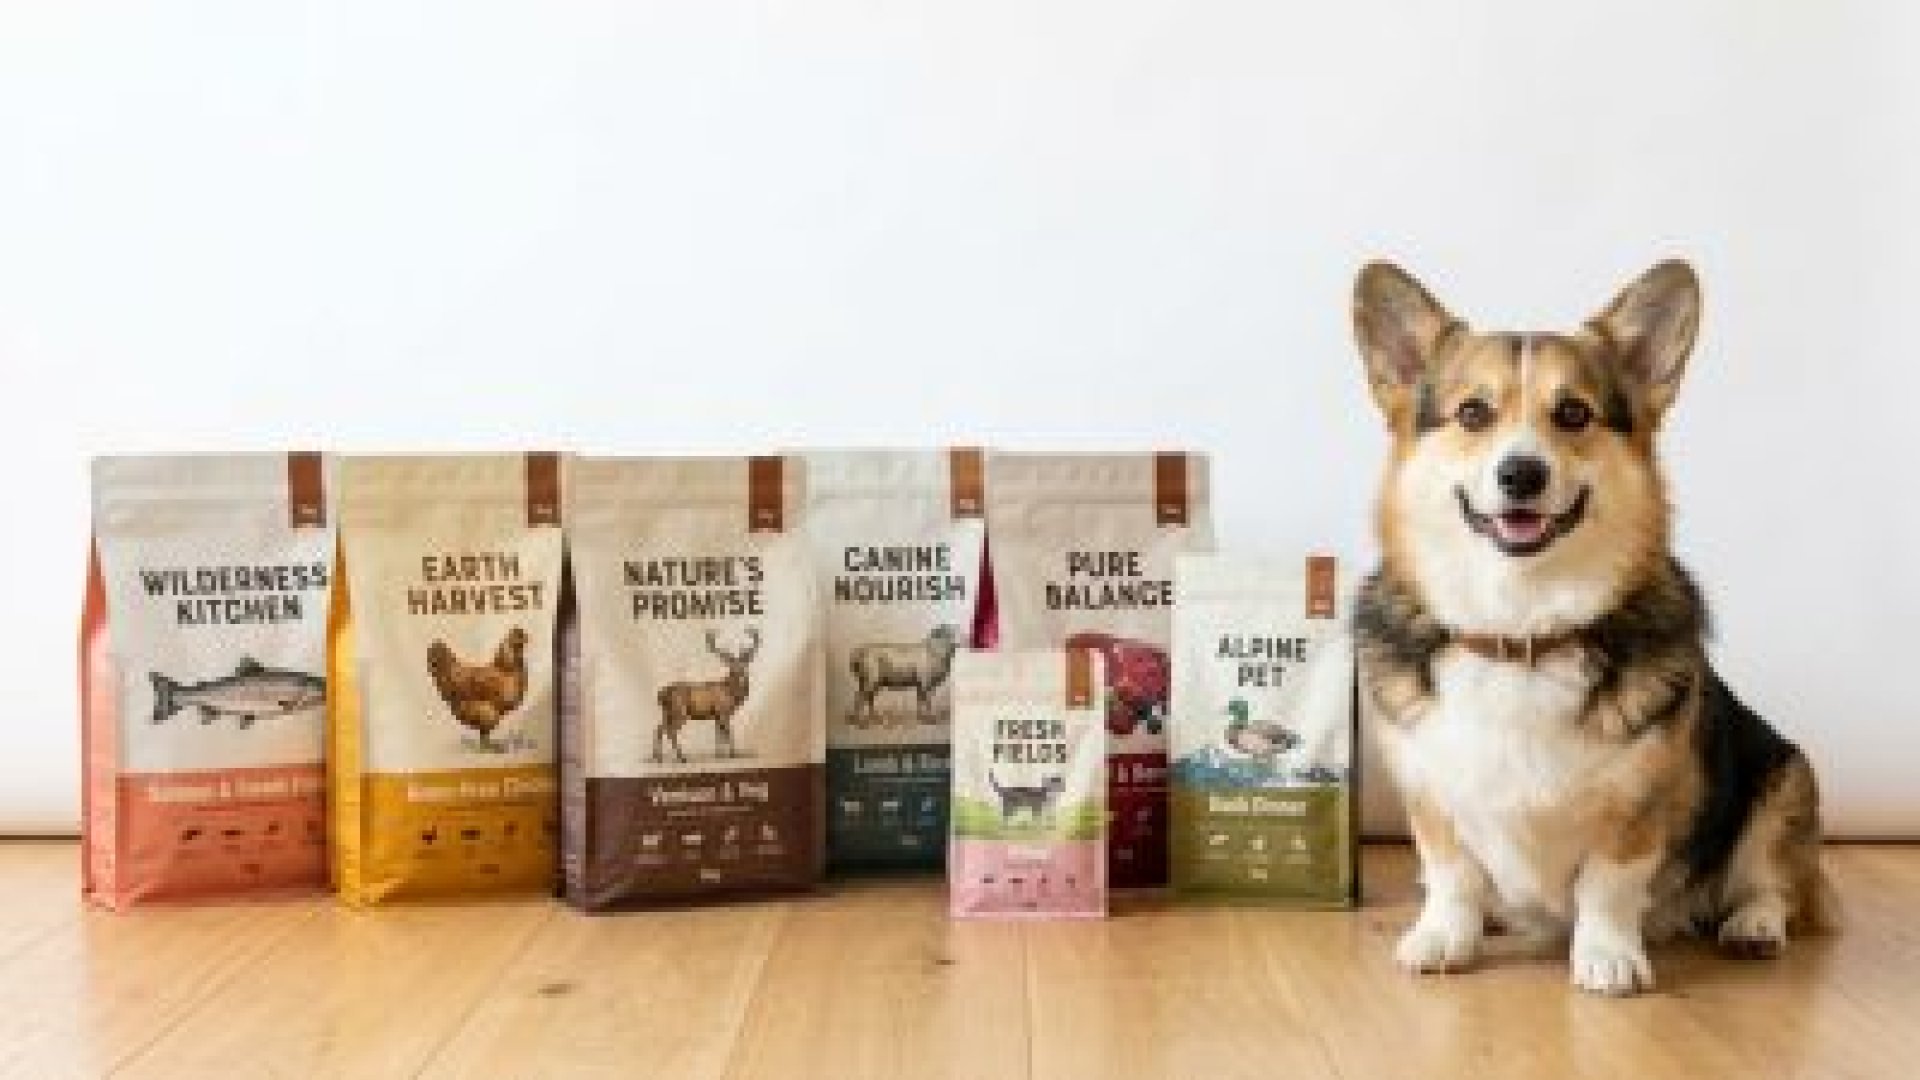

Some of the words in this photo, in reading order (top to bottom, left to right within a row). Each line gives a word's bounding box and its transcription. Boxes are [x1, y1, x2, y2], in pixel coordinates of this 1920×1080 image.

[422, 553, 520, 582] EARTH
[624, 557, 764, 587] NATURE'S
[844, 547, 952, 572] CANINE
[1069, 552, 1143, 576] PURE
[140, 566, 327, 595] WILDERNESS
[834, 576, 966, 602] NOURISH
[408, 582, 544, 614] HARVEST
[633, 589, 764, 619] PROMISE
[1046, 581, 1176, 610] BALANCE
[177, 595, 303, 624] KITCHEN
[1216, 637, 1307, 663] ALPINE
[1238, 666, 1287, 687] PET
[997, 719, 1066, 741] FRESH
[993, 743, 1067, 764] FIELDS
